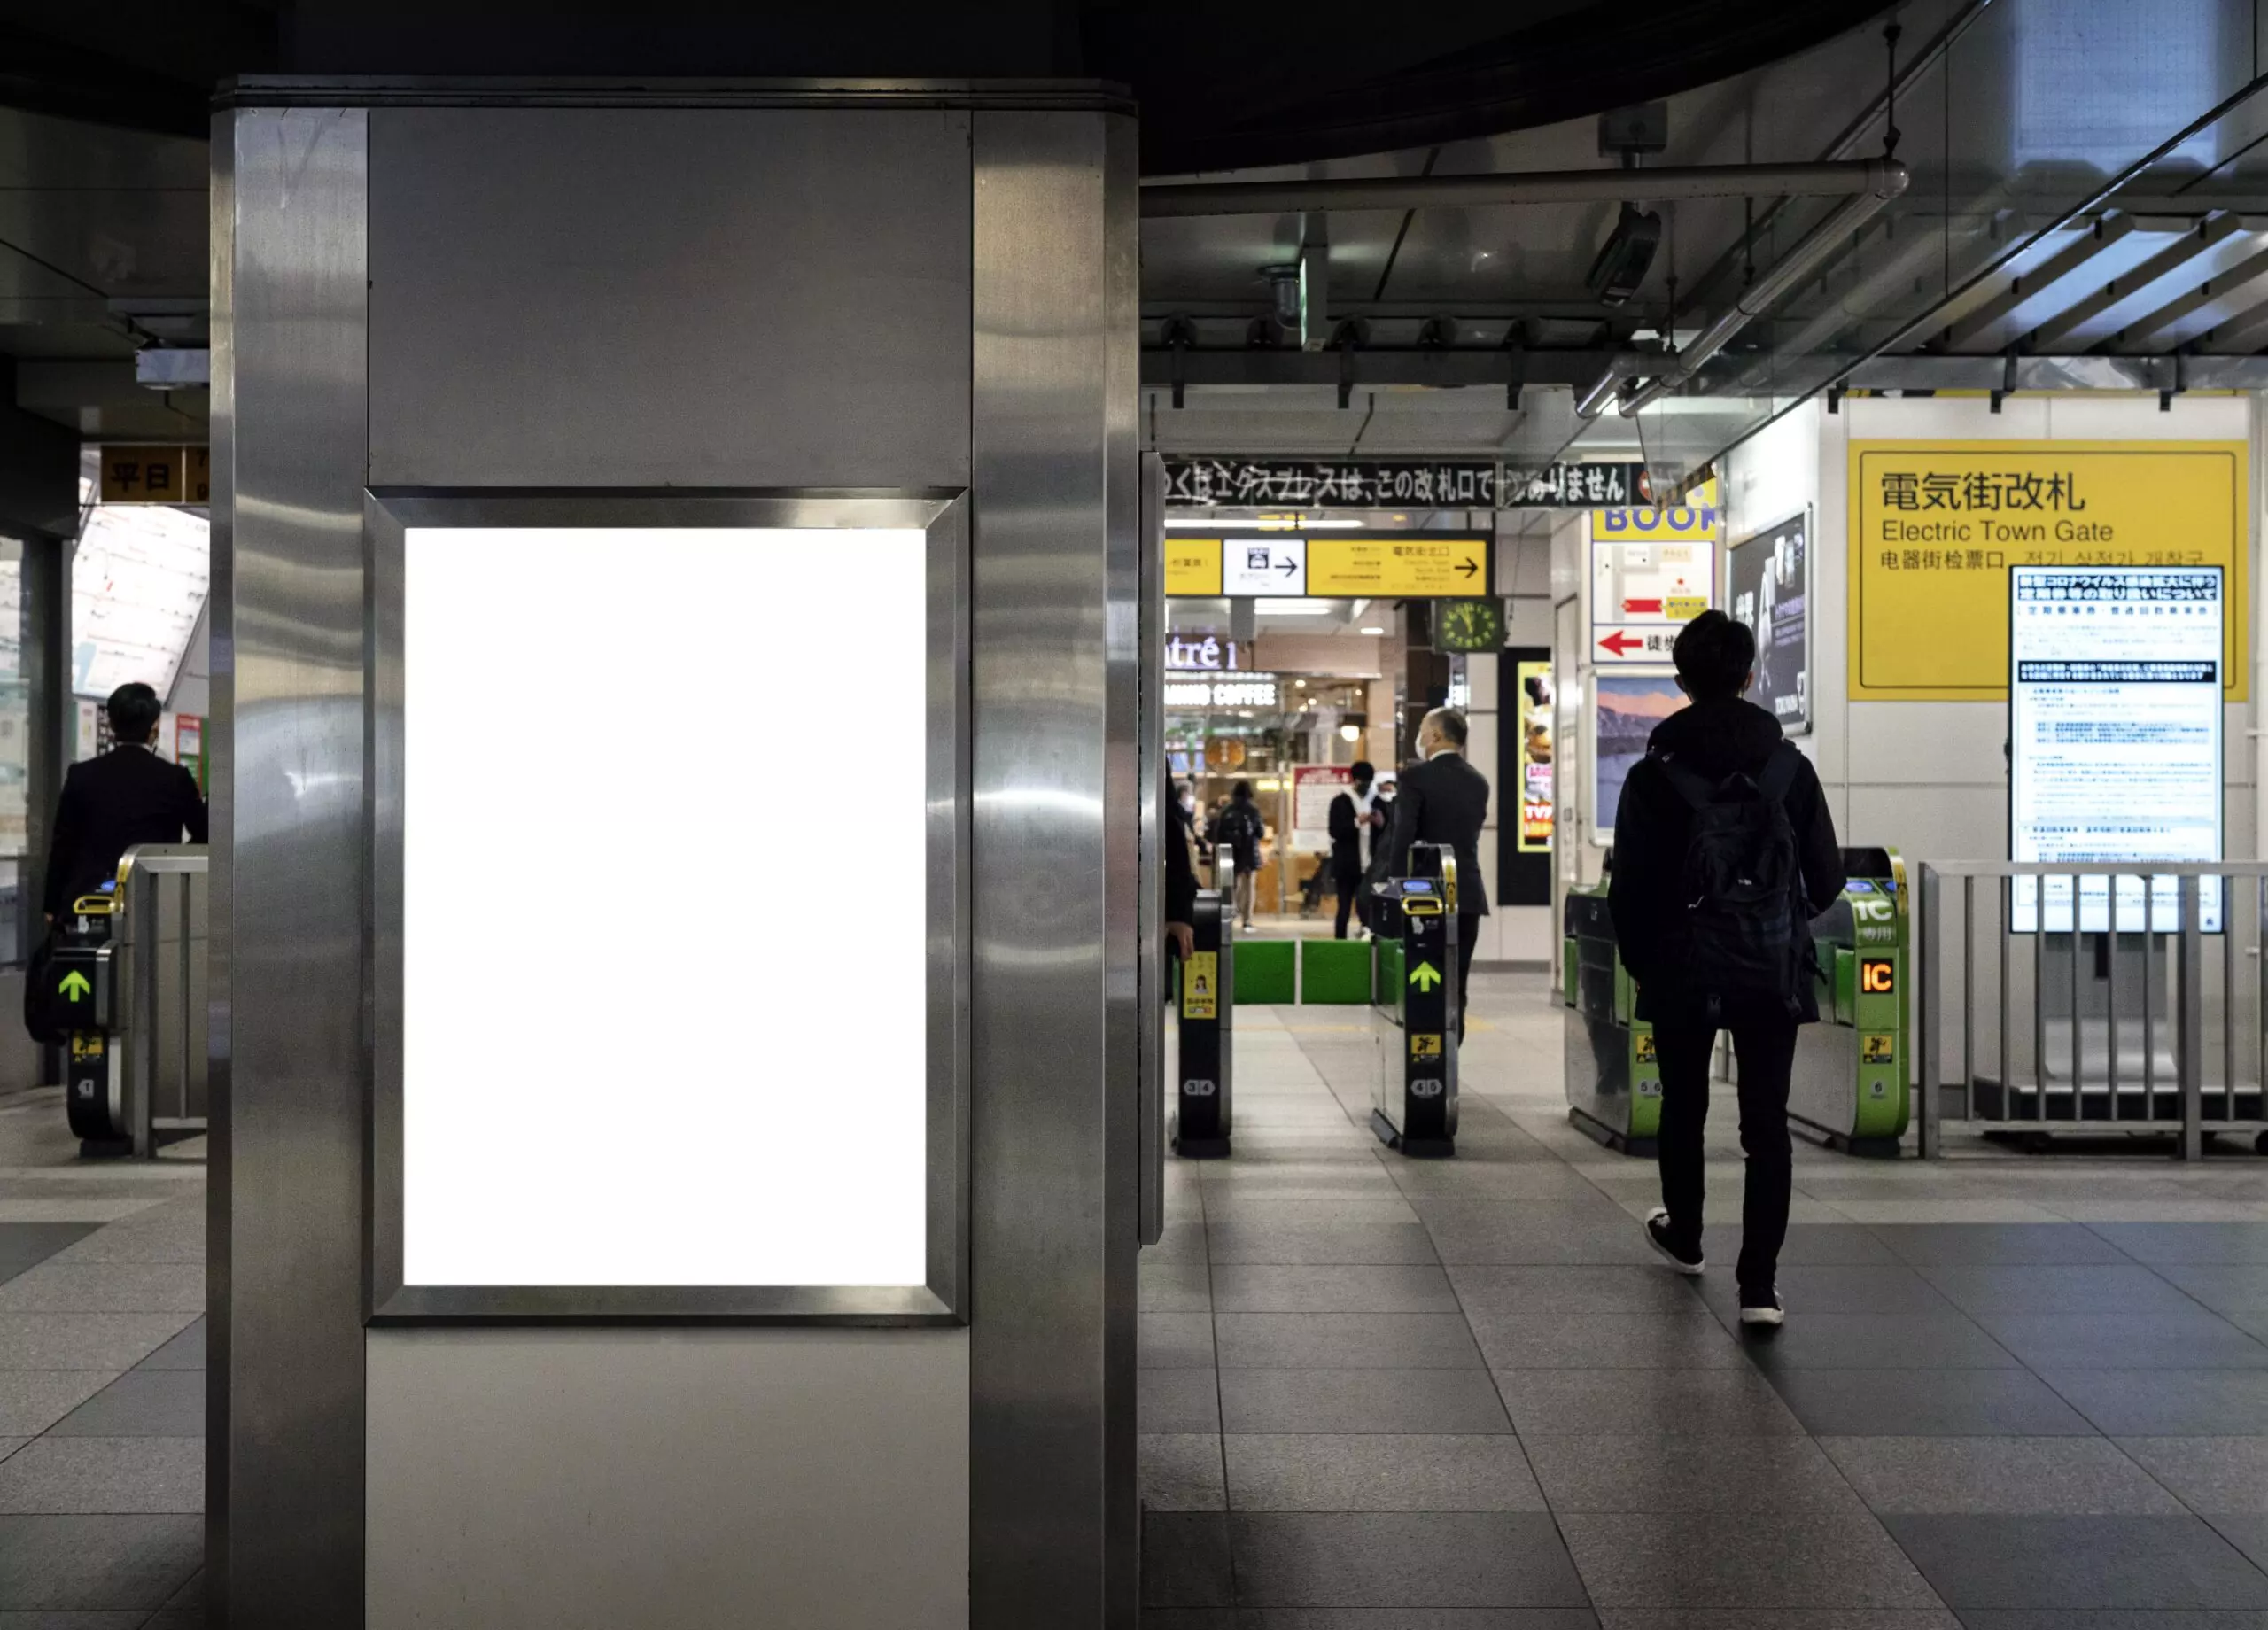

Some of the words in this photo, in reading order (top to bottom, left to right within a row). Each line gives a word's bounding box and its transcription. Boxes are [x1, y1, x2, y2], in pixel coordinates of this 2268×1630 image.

[110, 461, 170, 493] 平日
[1881, 472, 2085, 512] 電気街改札
[1883, 520, 1971, 542] Electric
[1979, 520, 2047, 542] Town
[2054, 520, 2114, 542] Gate
[1880, 549, 2006, 571] 电器街检票口
[1214, 684, 1276, 705] COFFEE
[1852, 900, 1893, 921] IC
[1863, 963, 1892, 991] IC
